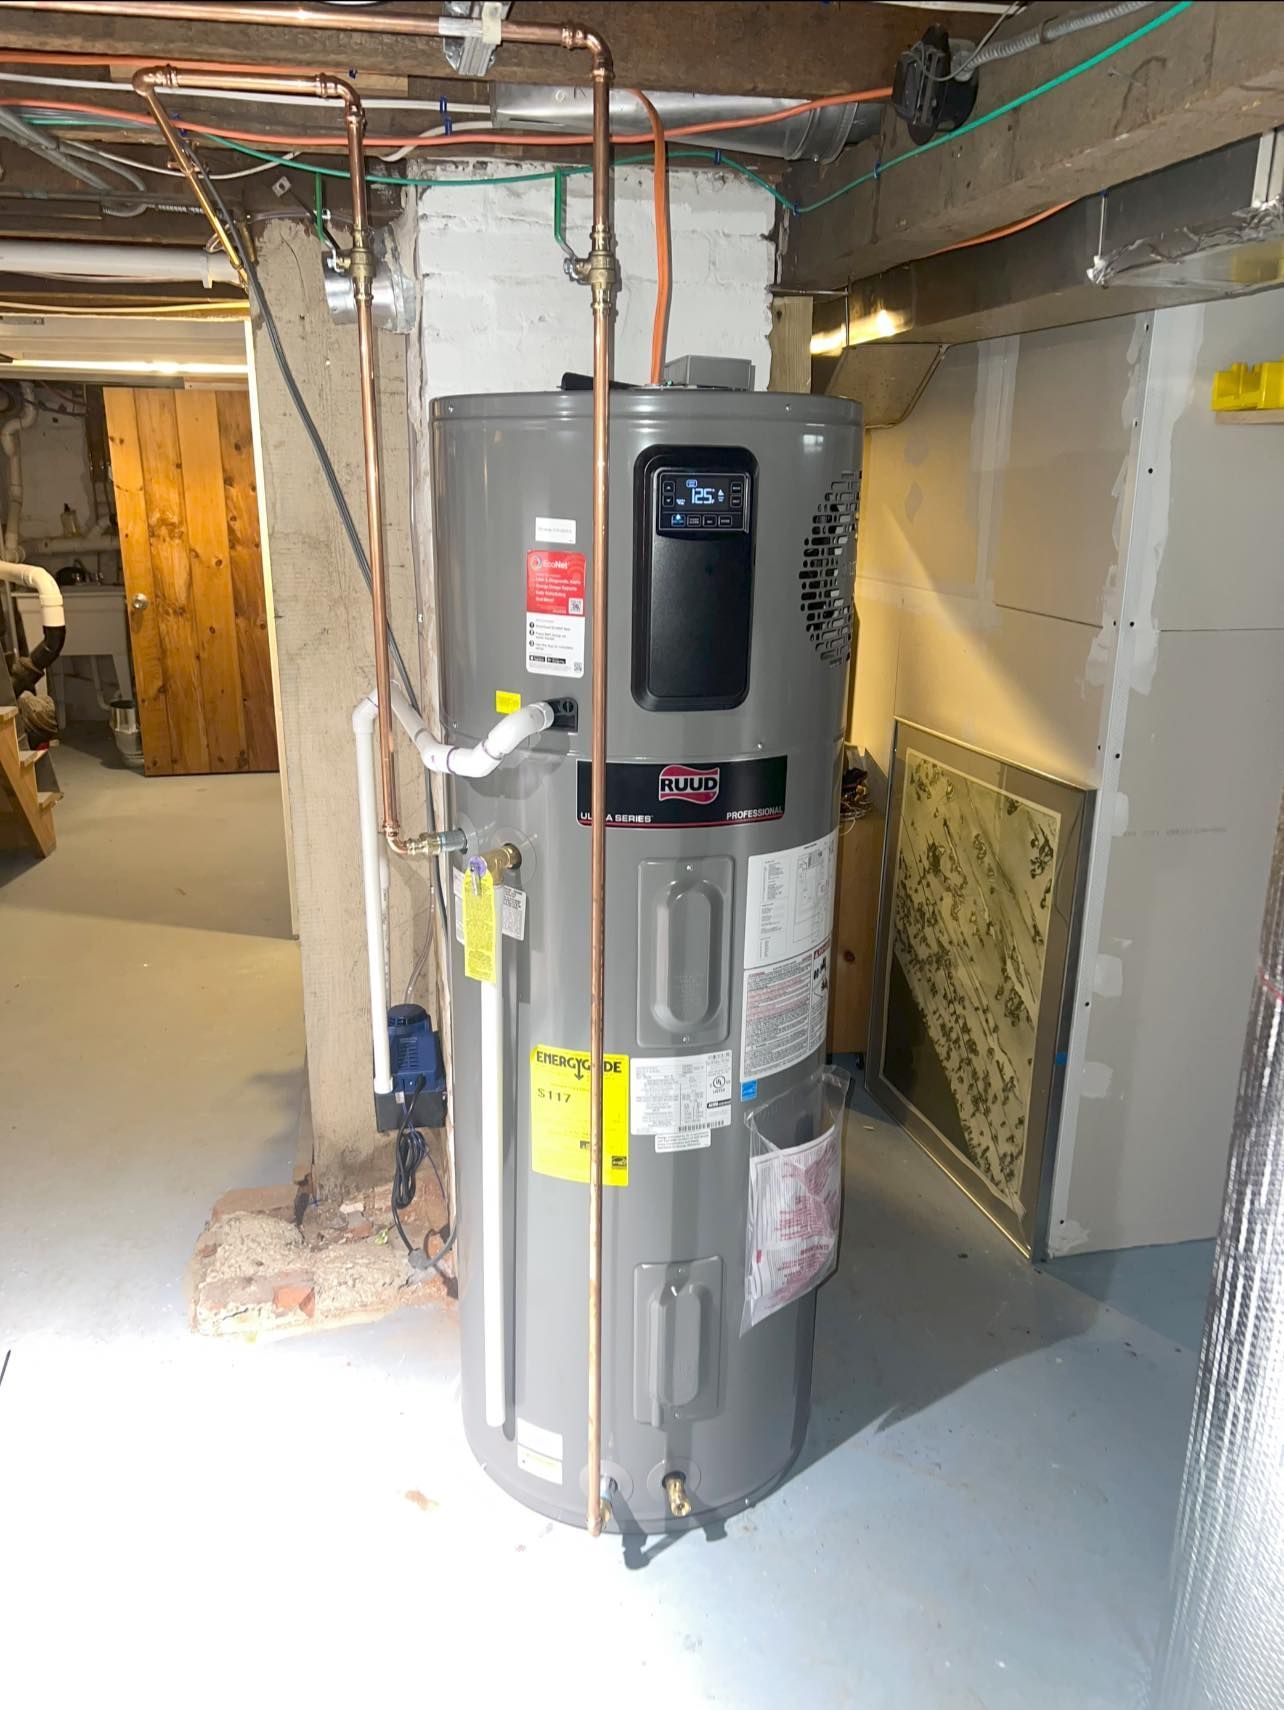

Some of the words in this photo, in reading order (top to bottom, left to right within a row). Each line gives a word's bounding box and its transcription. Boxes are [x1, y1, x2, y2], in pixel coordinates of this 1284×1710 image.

[661, 777, 718, 792] RUUD
[580, 811, 613, 822] ULA
[614, 814, 651, 823] SERIES
[726, 806, 783, 820] PROFESSIONAL
[536, 1051, 622, 1076] ENERGYGDE
